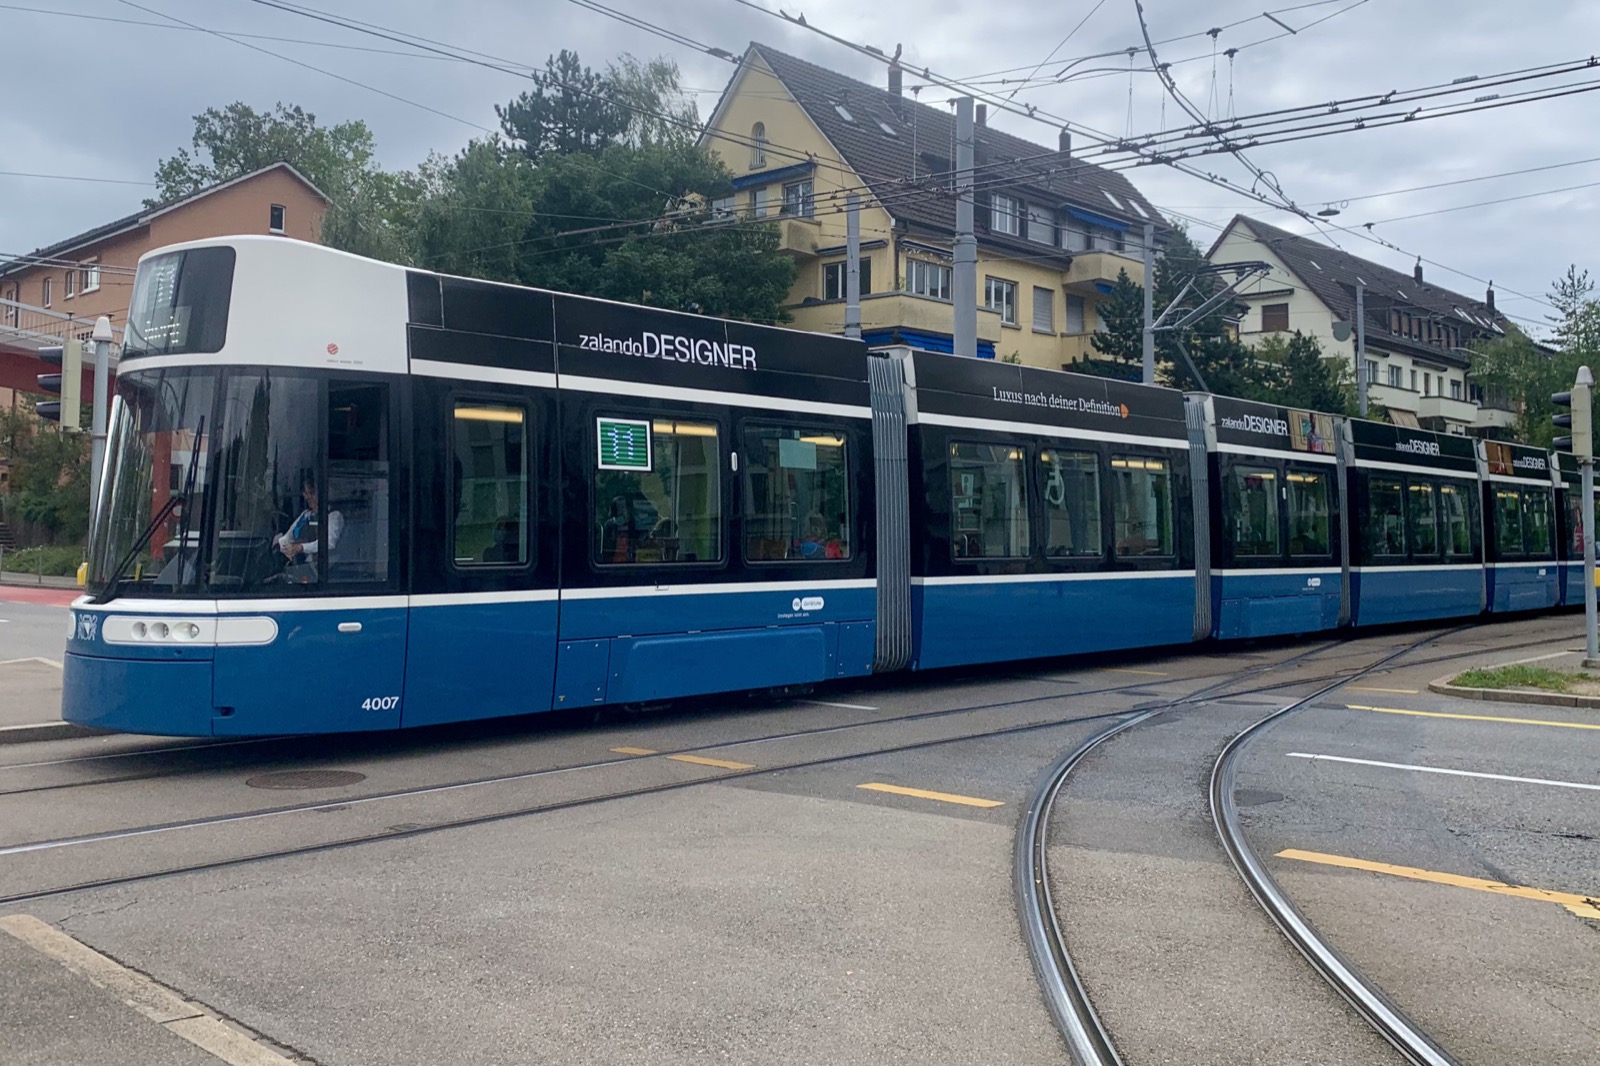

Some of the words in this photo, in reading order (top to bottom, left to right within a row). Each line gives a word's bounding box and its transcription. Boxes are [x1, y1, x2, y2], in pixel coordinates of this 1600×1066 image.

[992, 386, 1023, 404] Luxus
[1024, 391, 1048, 407] nach
[1049, 393, 1078, 411] deiner
[1078, 397, 1121, 417] Definition
[361, 696, 400, 711] 4007
